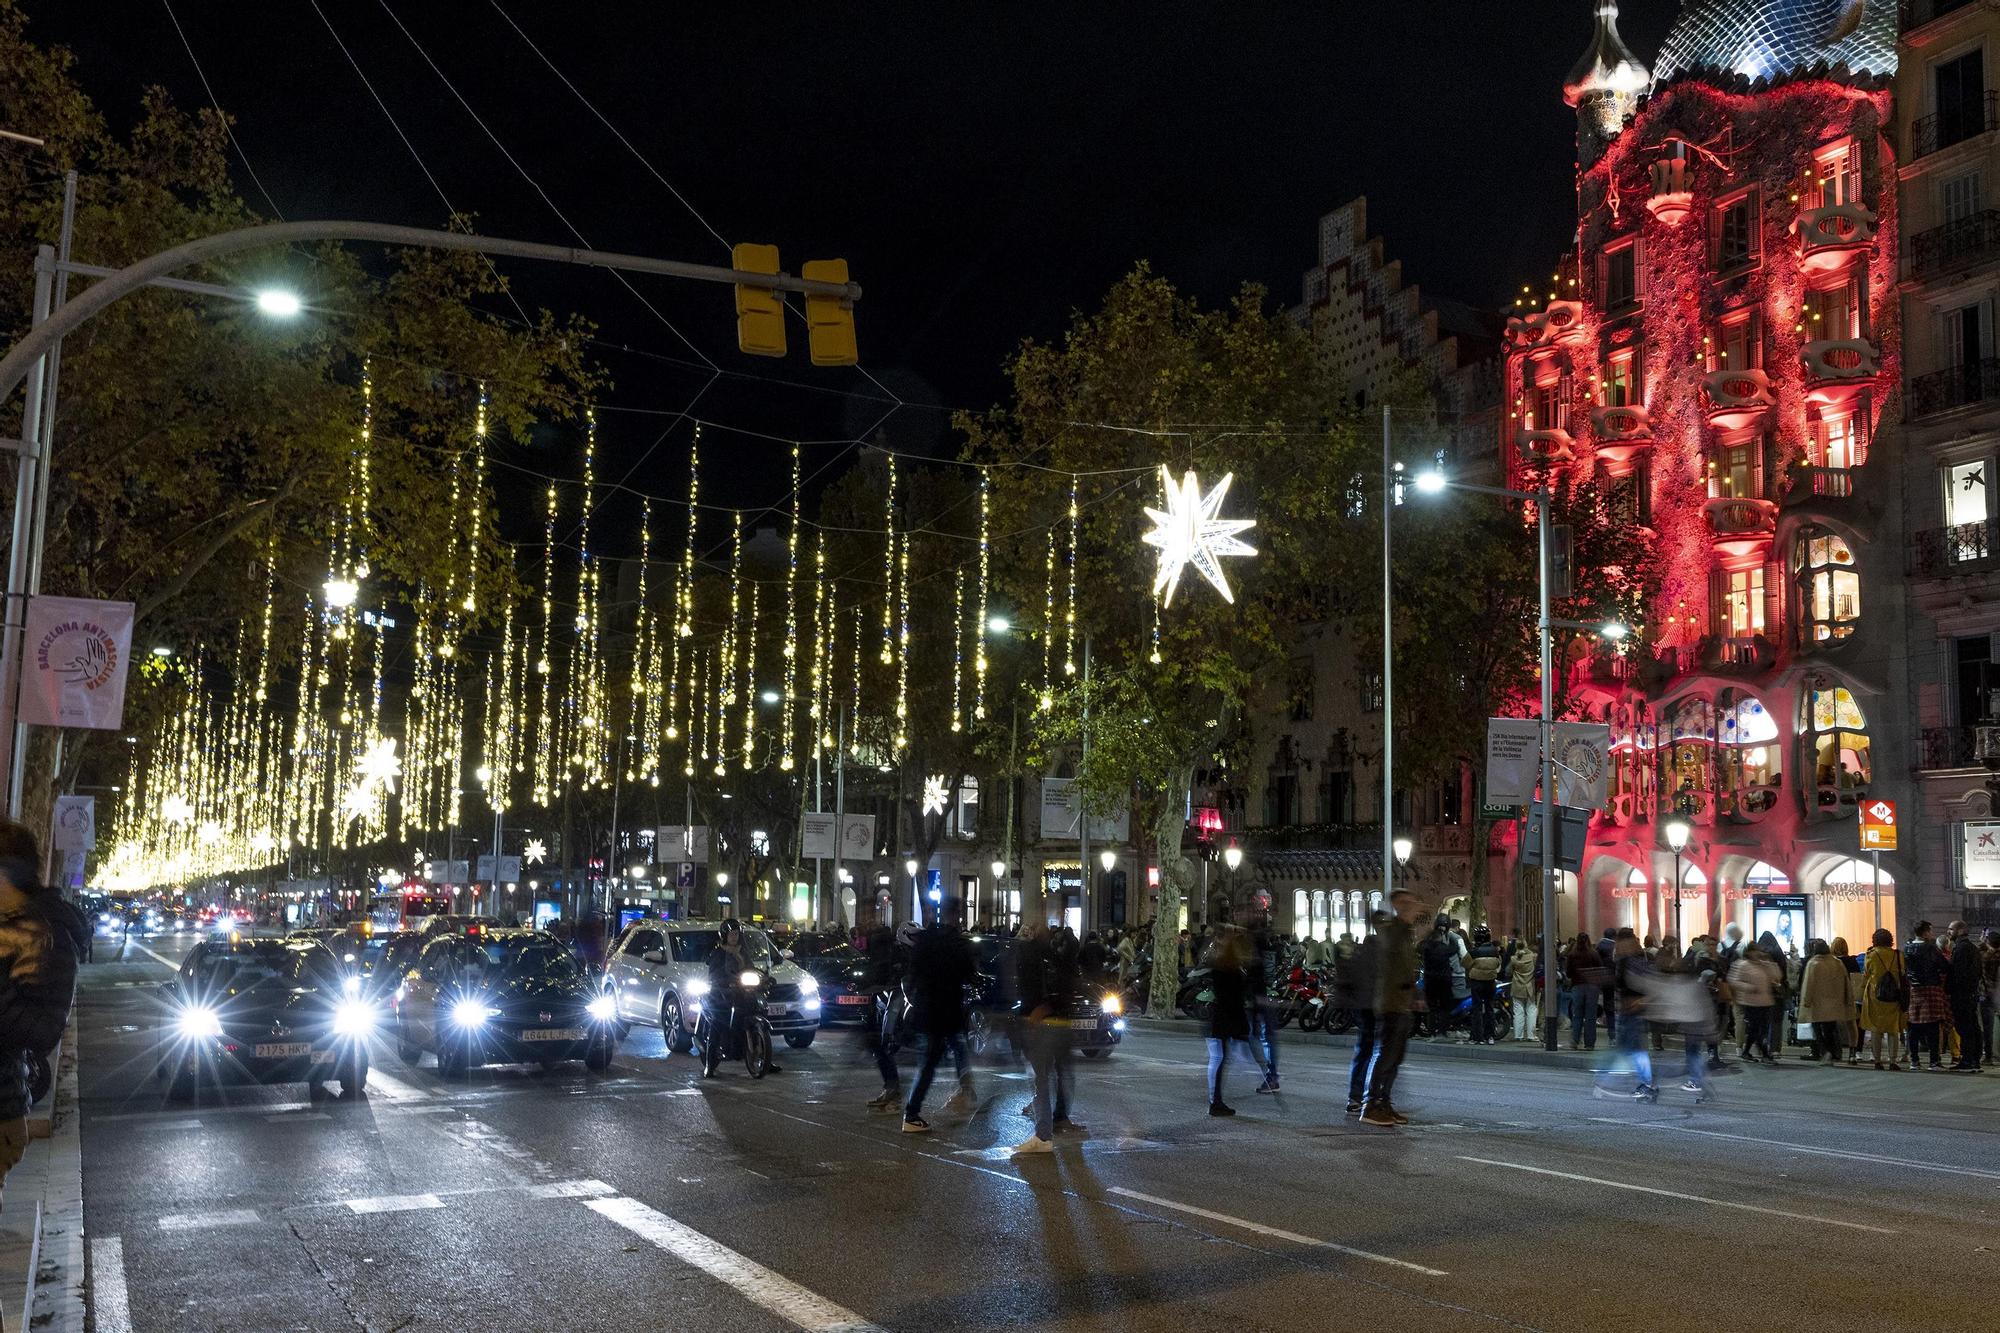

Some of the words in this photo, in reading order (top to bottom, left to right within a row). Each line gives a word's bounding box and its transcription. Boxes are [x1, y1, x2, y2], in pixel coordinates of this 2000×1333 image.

[38, 622, 79, 670] BARCELONA
[83, 622, 117, 690] ANTIMASCLISTA
[1877, 806, 1885, 815] M
[681, 862, 693, 877] P
[1612, 888, 1638, 898] CASA
[258, 1044, 285, 1056] 2175
